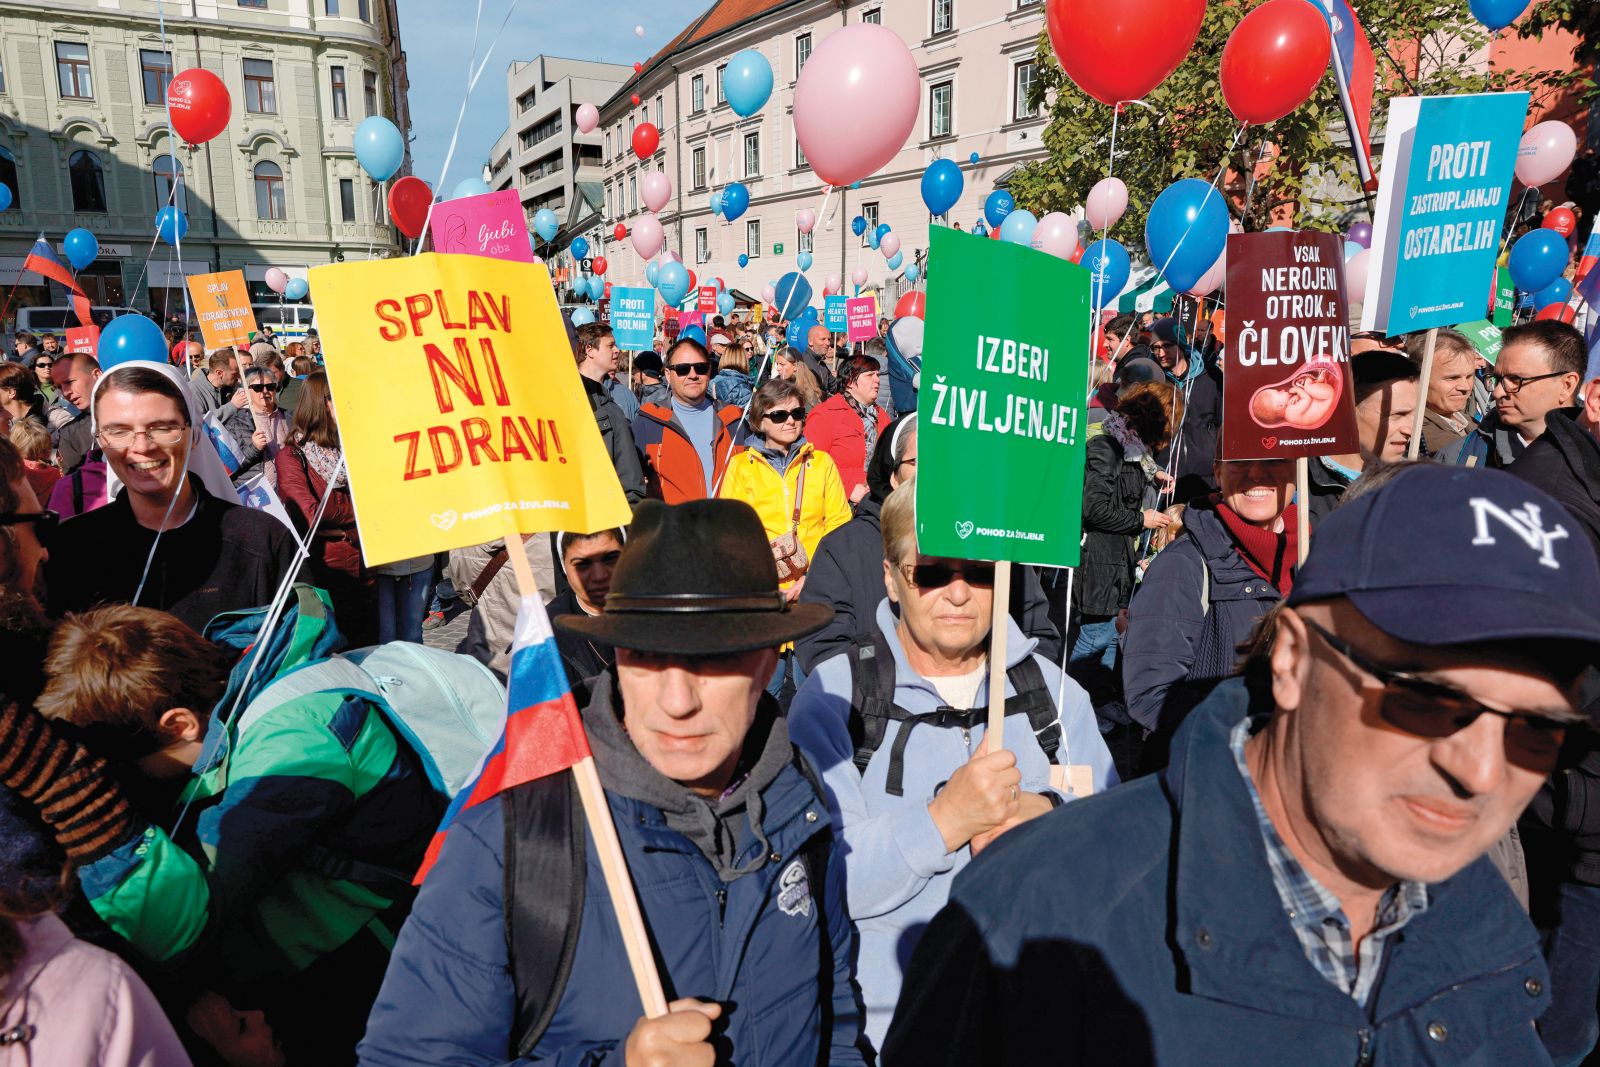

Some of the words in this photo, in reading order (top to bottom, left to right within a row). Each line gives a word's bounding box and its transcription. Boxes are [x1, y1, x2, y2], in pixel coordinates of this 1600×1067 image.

[1427, 140, 1491, 181] PROTI
[1410, 187, 1502, 216] ZASTRUPLJANJU
[478, 219, 517, 252] ljubi
[1404, 219, 1496, 261] OSTARELIH
[490, 243, 511, 255] oba
[1294, 245, 1320, 263] VSAK
[207, 282, 228, 293] SPLAV
[1262, 266, 1337, 291] NEROJENI
[215, 294, 228, 307] NI
[620, 299, 645, 310] PROTI
[853, 305, 869, 314] PROTI
[1266, 295, 1323, 319] OTROK
[1326, 302, 1336, 318] JE
[200, 307, 249, 322] ZDRAVSTVENA
[213, 319, 243, 331] OSKRBA!
[374, 288, 512, 342] SPLAV
[617, 319, 647, 330] BOLNIH
[1238, 320, 1349, 367] ČLOVEK!
[976, 334, 1049, 383] IZBERI
[422, 337, 511, 415] NI
[931, 374, 1078, 446] ŽIVLJENJE!
[393, 415, 567, 481] ZDRAV!
[462, 503, 501, 521] POHOD
[501, 501, 518, 511] ZA
[519, 499, 571, 510] ŽIVLJENJE
[976, 527, 1006, 538] POHOD
[1006, 530, 1015, 538] ZA
[1015, 530, 1045, 541] ŽIVLJENJE
[1469, 498, 1569, 569] NY
